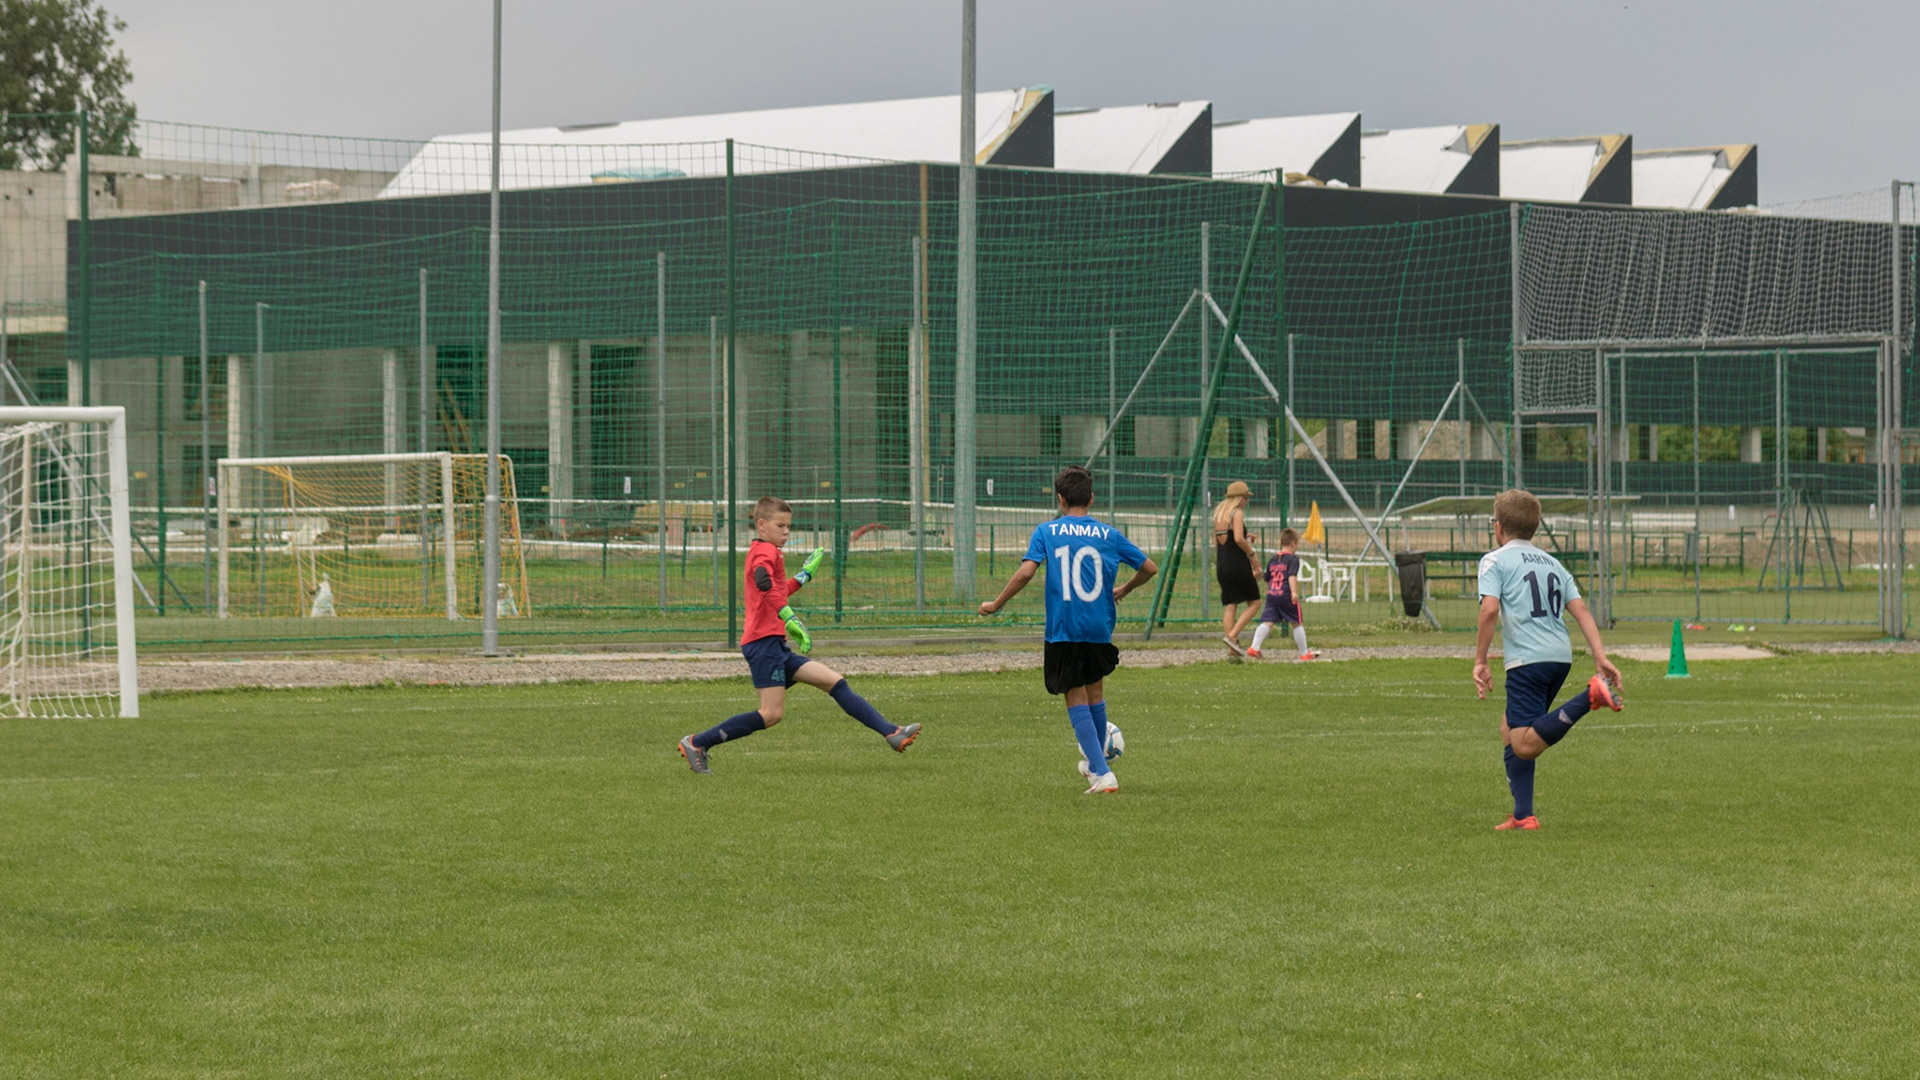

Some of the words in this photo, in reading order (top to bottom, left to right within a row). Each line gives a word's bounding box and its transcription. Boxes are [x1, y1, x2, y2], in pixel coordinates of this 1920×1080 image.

[1049, 523, 1109, 540] TANMAY
[1055, 545, 1103, 602] 10
[1521, 552, 1554, 567] AARNI
[1523, 570, 1561, 619] 16
